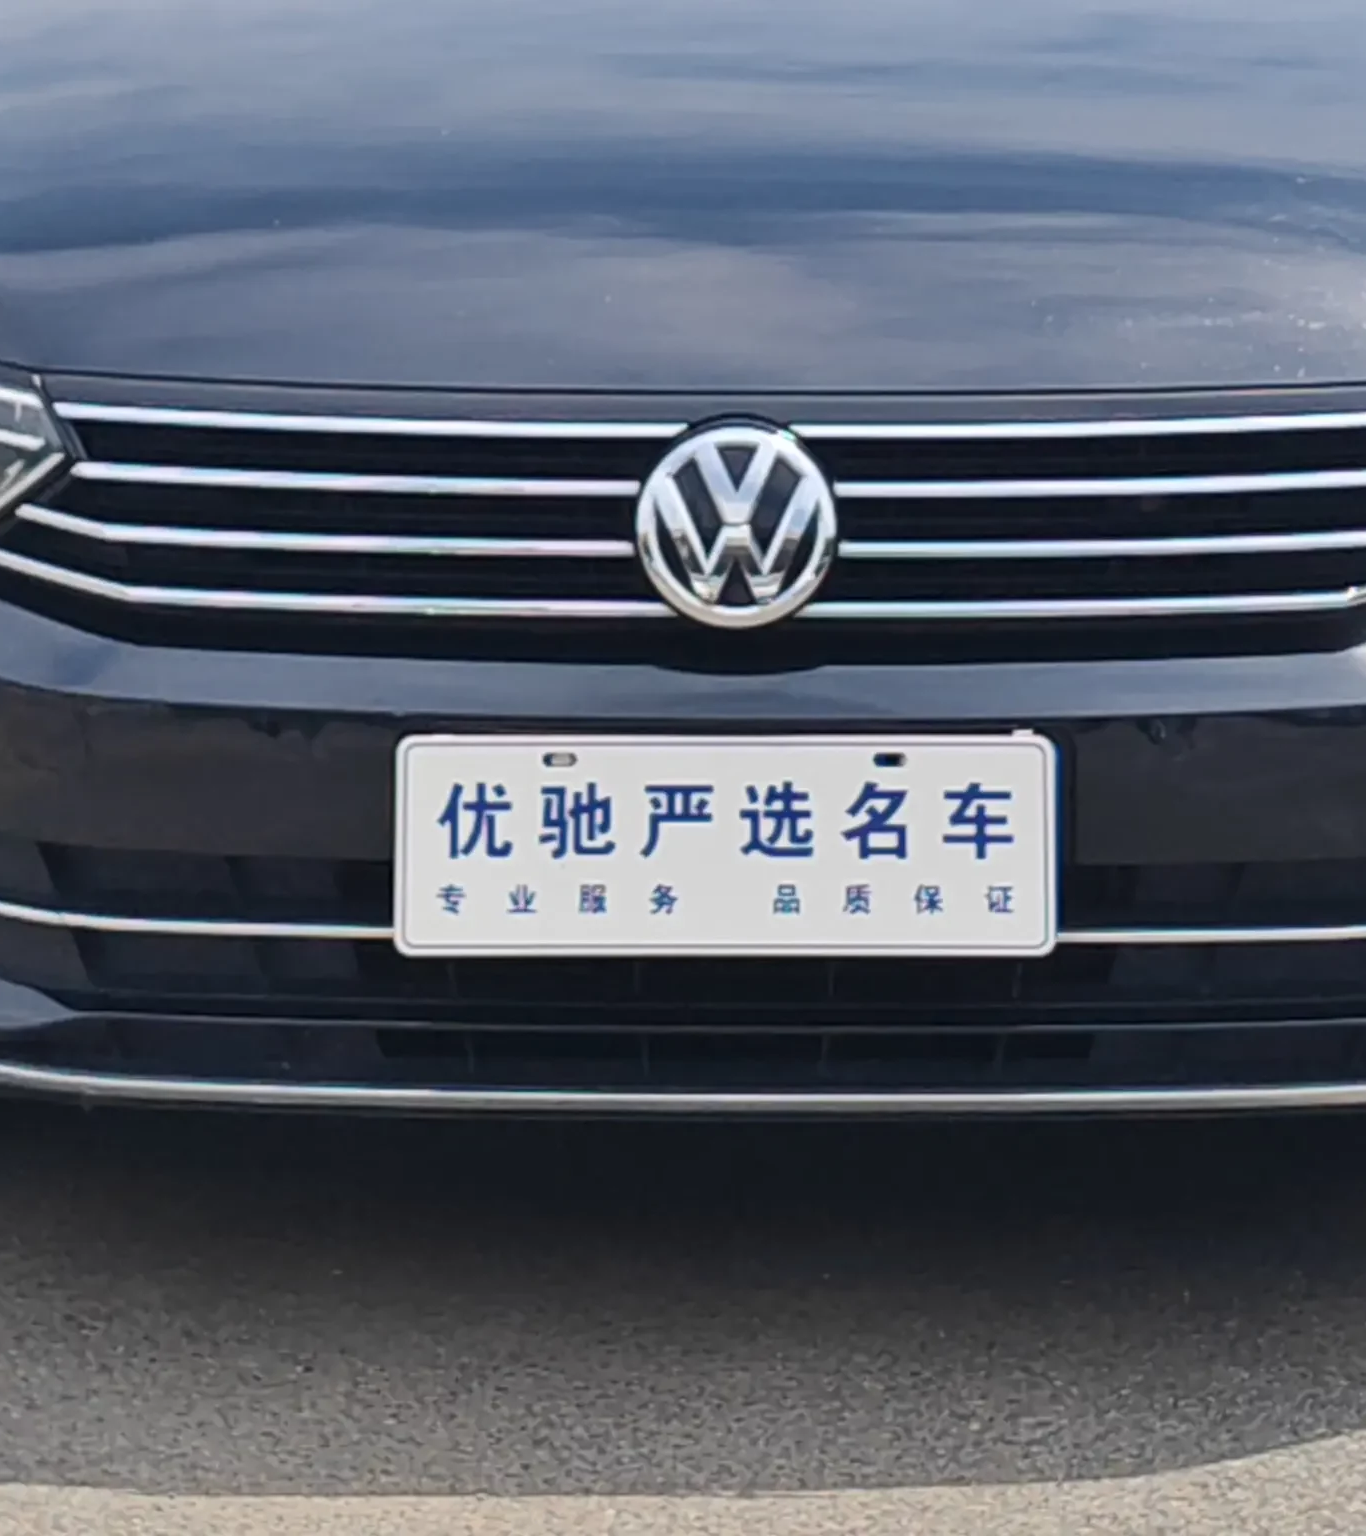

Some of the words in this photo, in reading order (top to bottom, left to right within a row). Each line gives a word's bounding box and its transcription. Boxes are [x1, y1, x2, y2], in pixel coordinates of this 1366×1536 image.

[437, 781, 1015, 860] 优驰严选名车
[436, 884, 679, 915] 专业服务
[772, 884, 1015, 915] 品质保证
